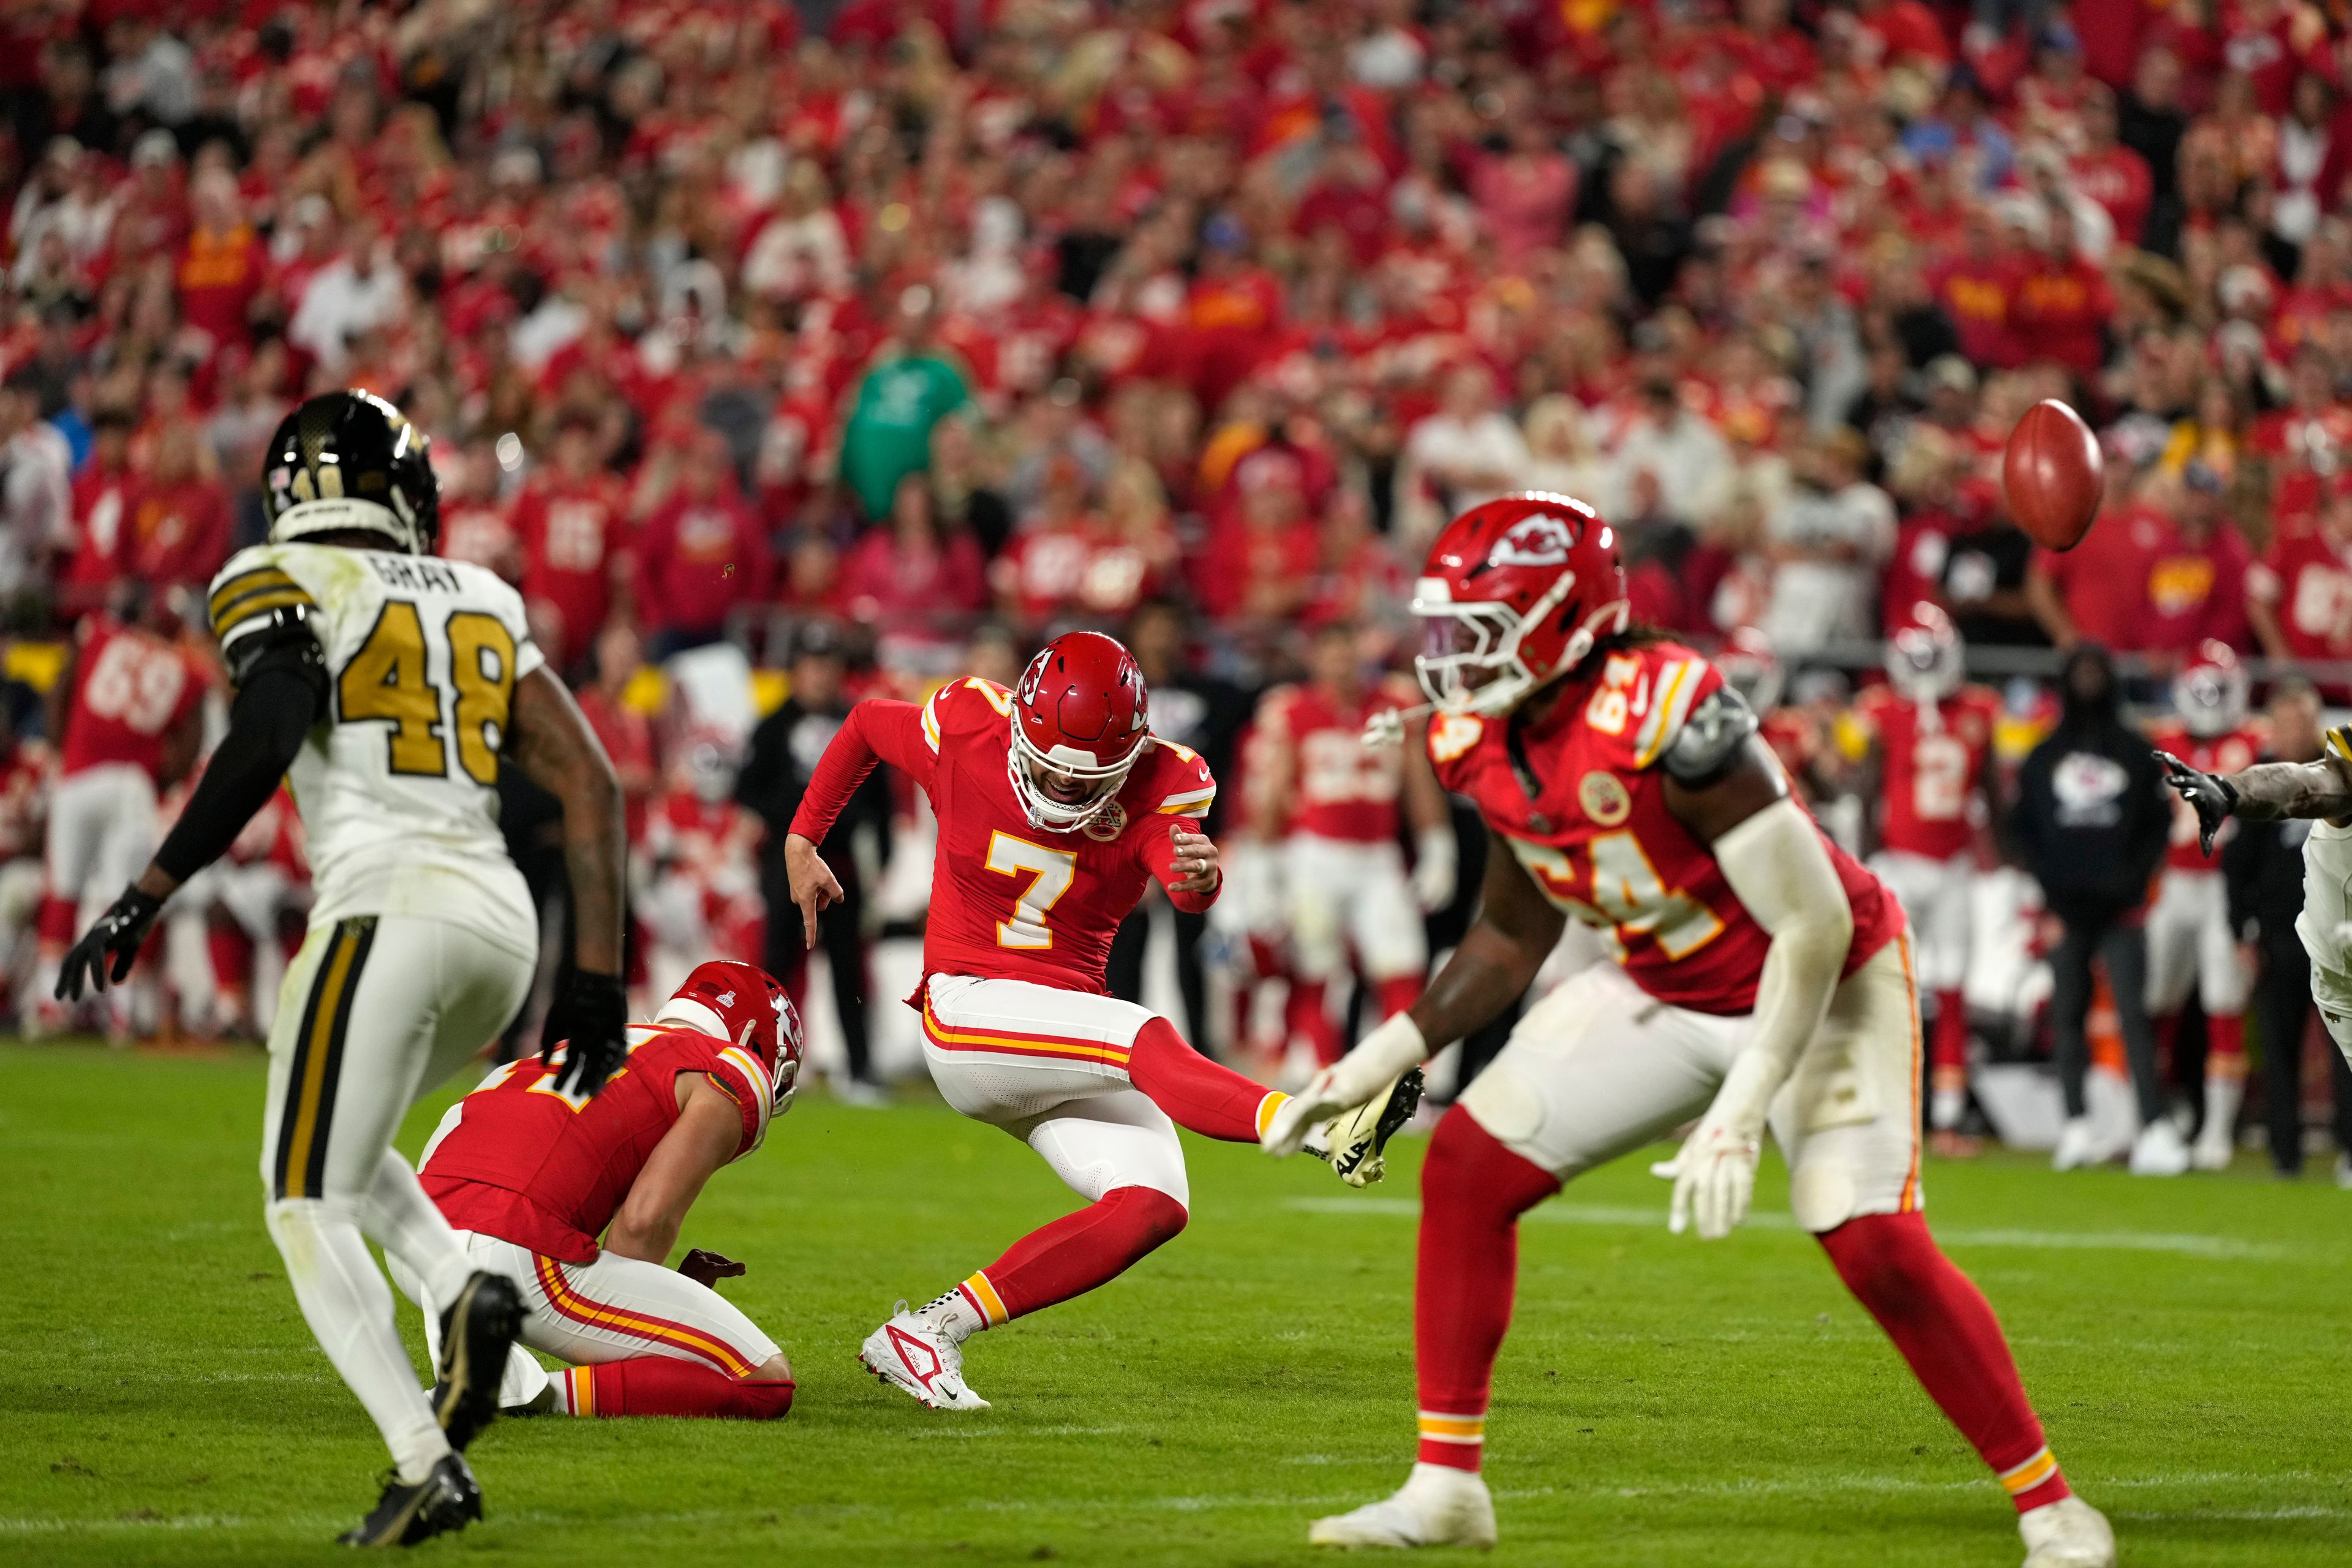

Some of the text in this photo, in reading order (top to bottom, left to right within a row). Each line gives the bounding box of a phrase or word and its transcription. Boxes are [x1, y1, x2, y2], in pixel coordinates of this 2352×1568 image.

[368, 556, 461, 593] GRAY
[86, 634, 185, 734] 69
[337, 598, 517, 786] 48
[963, 676, 1012, 718] 7
[984, 829, 1078, 950] 7
[1506, 828, 1727, 965] 64
[718, 995, 733, 1005] CATCH
[904, 1346, 920, 1373] ALPHA
